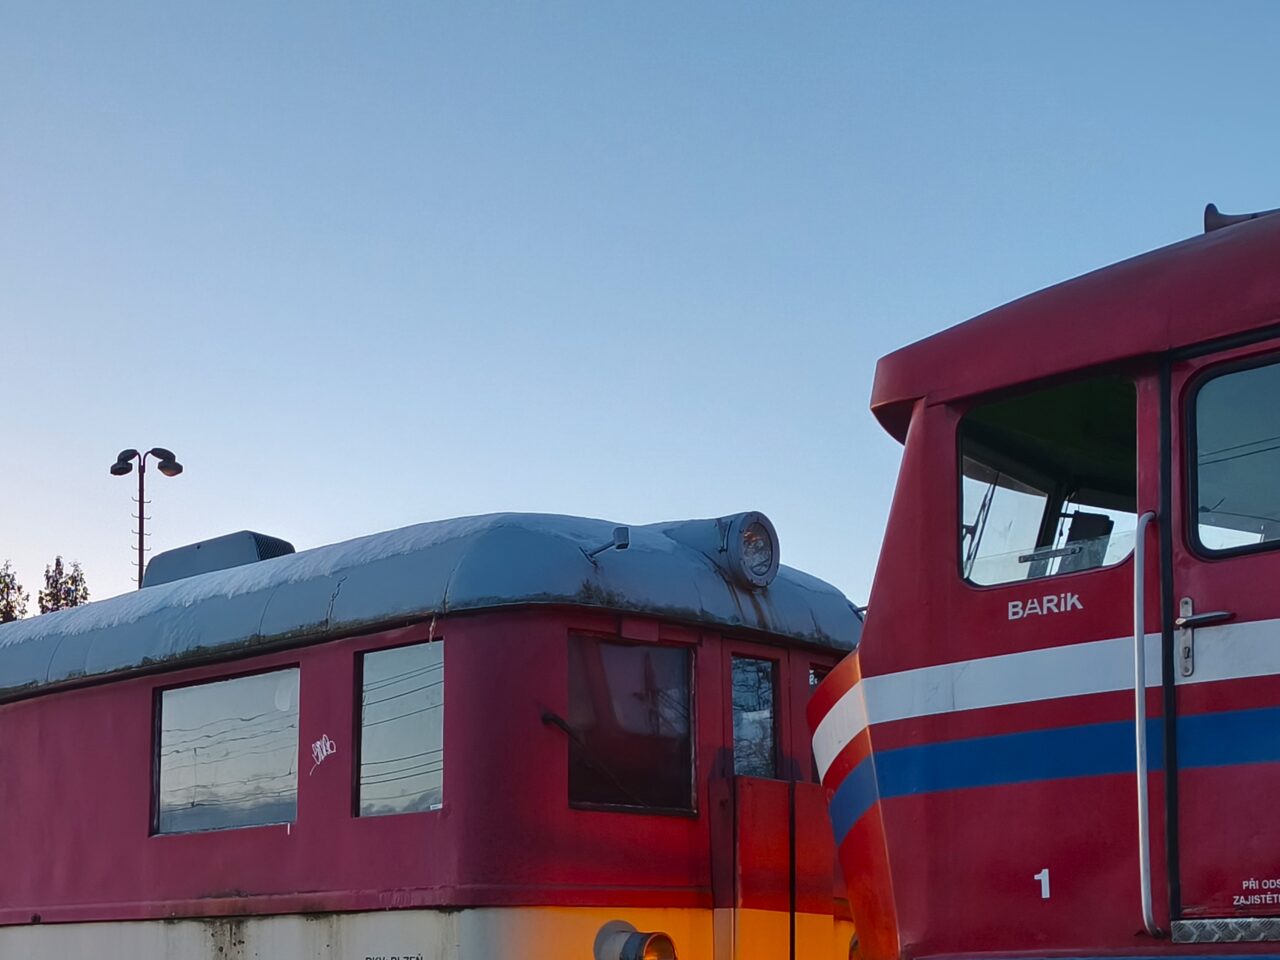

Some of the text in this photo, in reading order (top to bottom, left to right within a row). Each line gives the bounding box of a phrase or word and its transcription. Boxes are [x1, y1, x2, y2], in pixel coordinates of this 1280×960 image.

[1033, 868, 1050, 899] 1
[1242, 877, 1259, 890] PŘI
[1232, 891, 1280, 905] ZAJISTĚT
